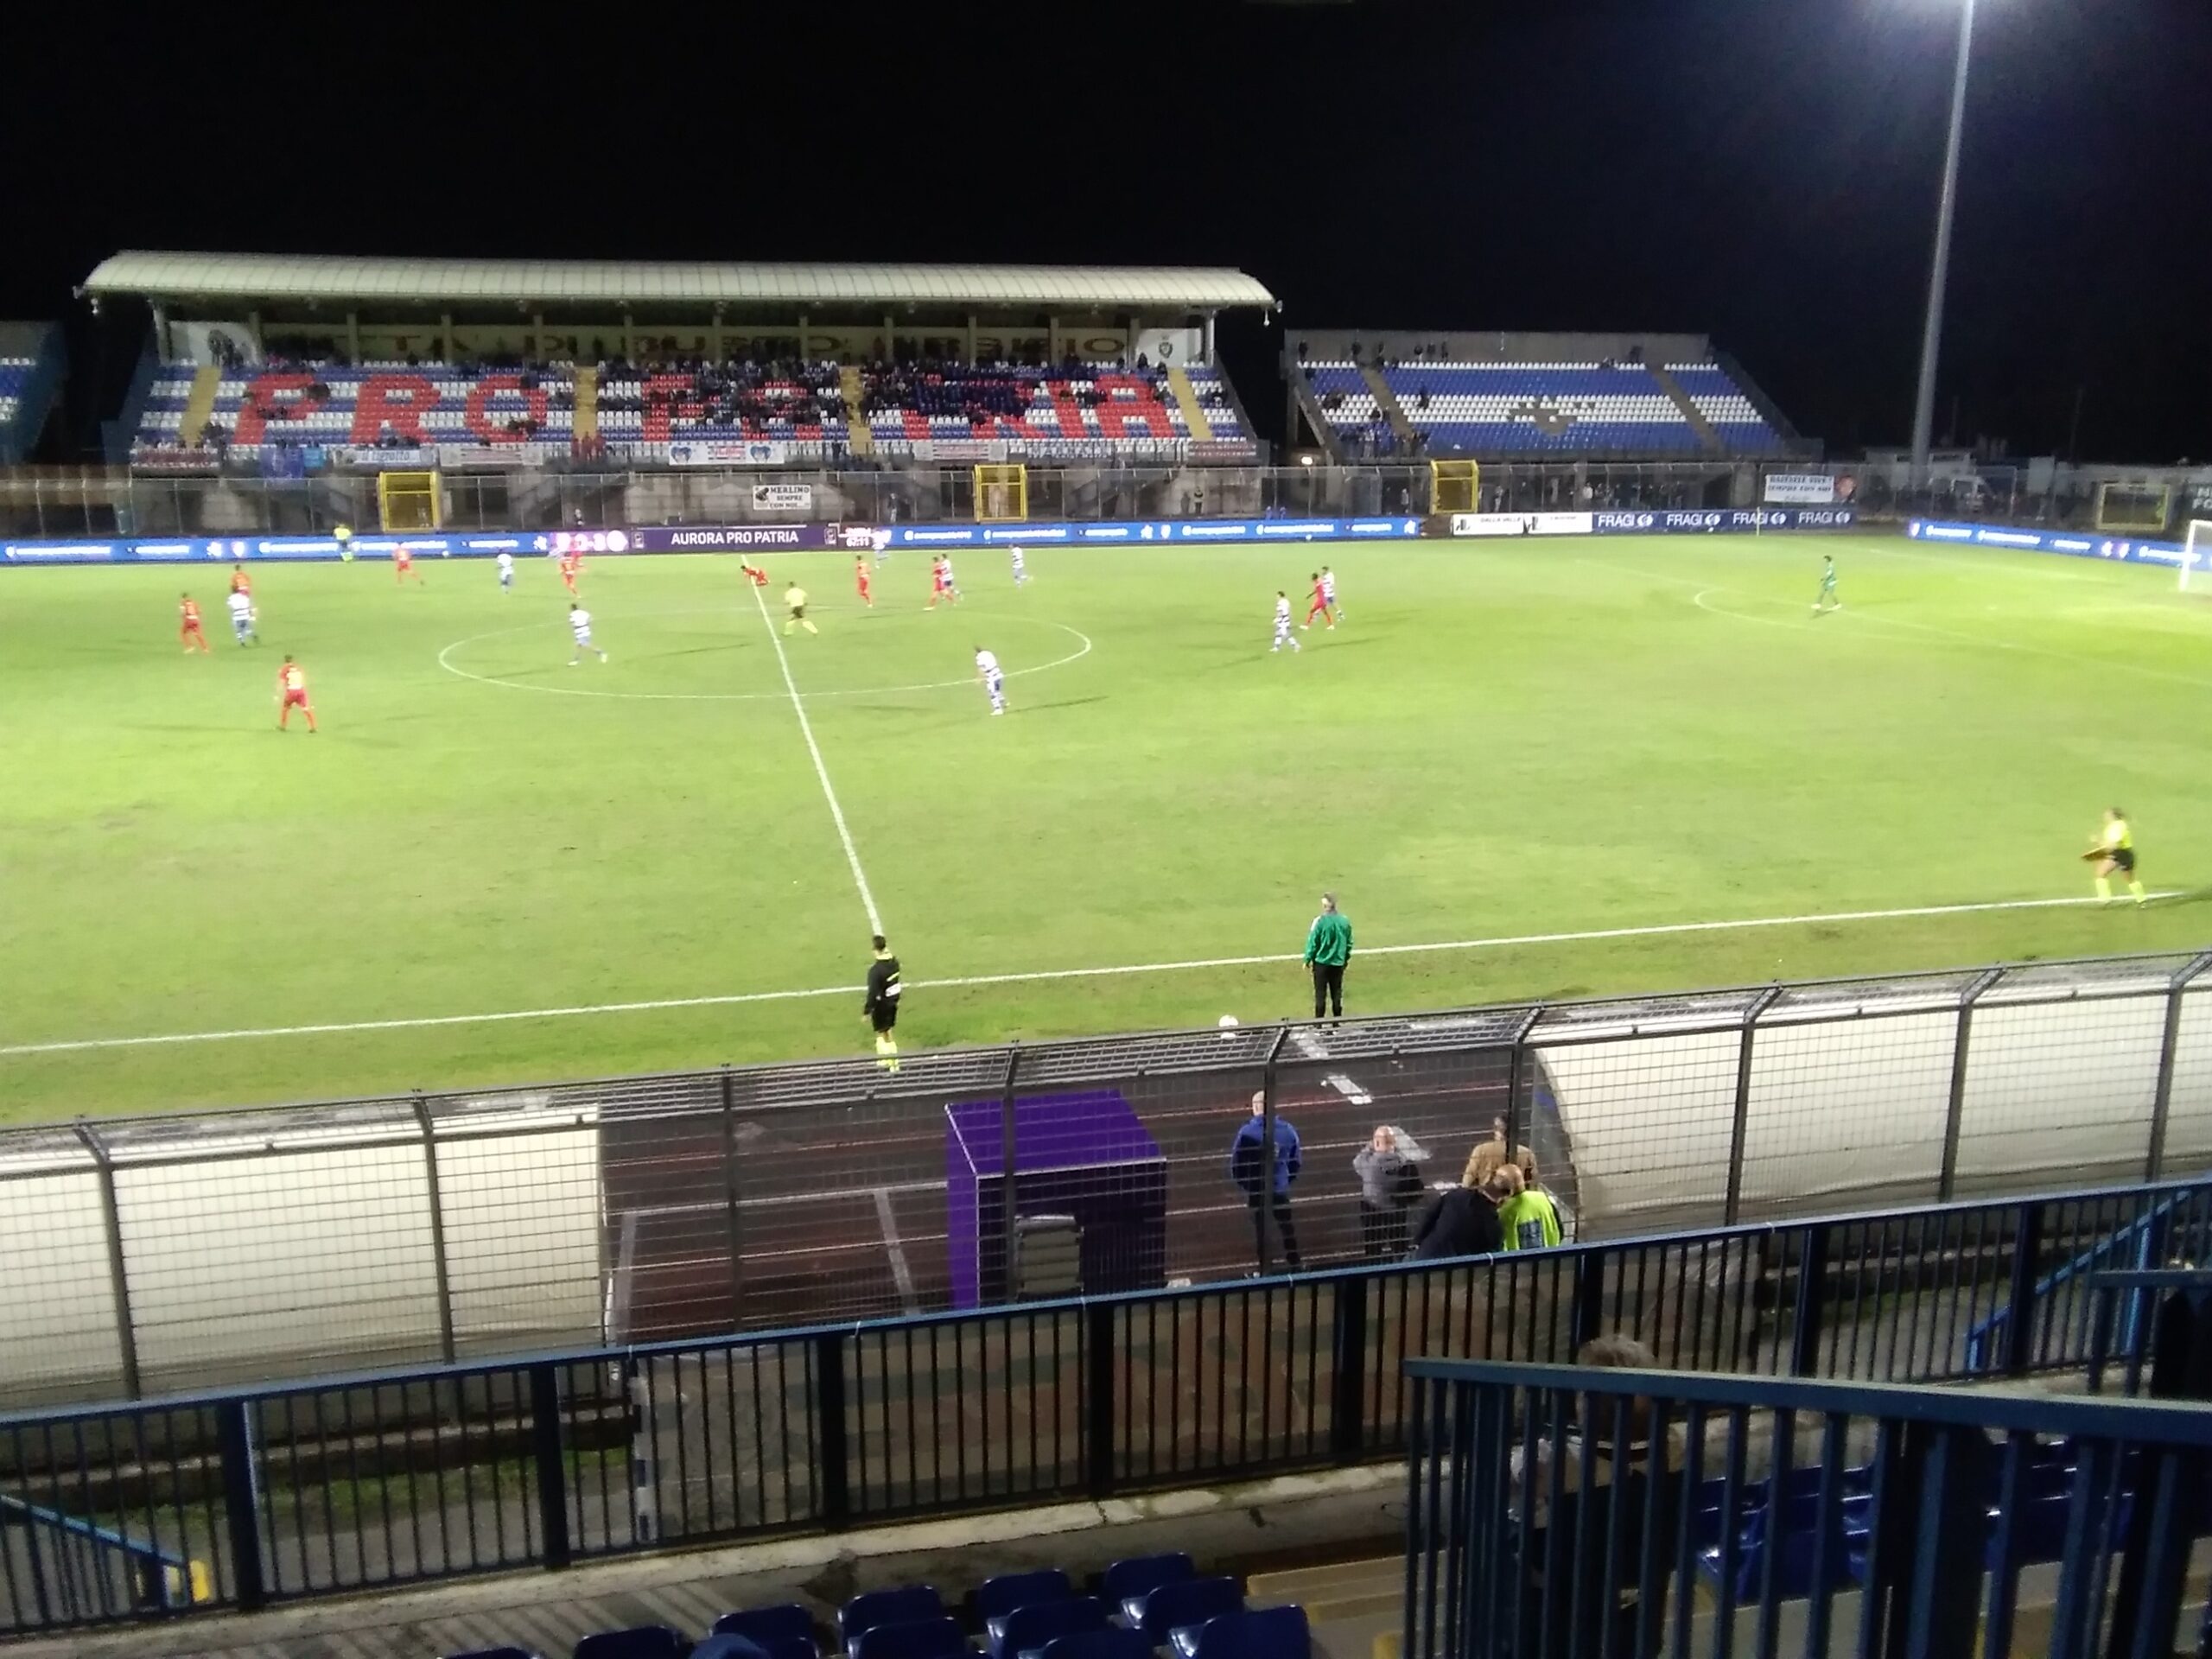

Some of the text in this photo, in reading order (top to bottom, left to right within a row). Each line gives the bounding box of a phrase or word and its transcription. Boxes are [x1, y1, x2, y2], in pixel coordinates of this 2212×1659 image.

[231, 373, 550, 444] PRO
[1598, 514, 1635, 527] FRAGI
[1667, 513, 1703, 525] FRAGI
[1733, 512, 1768, 524] FRAGI
[1798, 511, 1833, 524] FRAGI
[671, 530, 799, 545] AURORA PRO PATRIA
